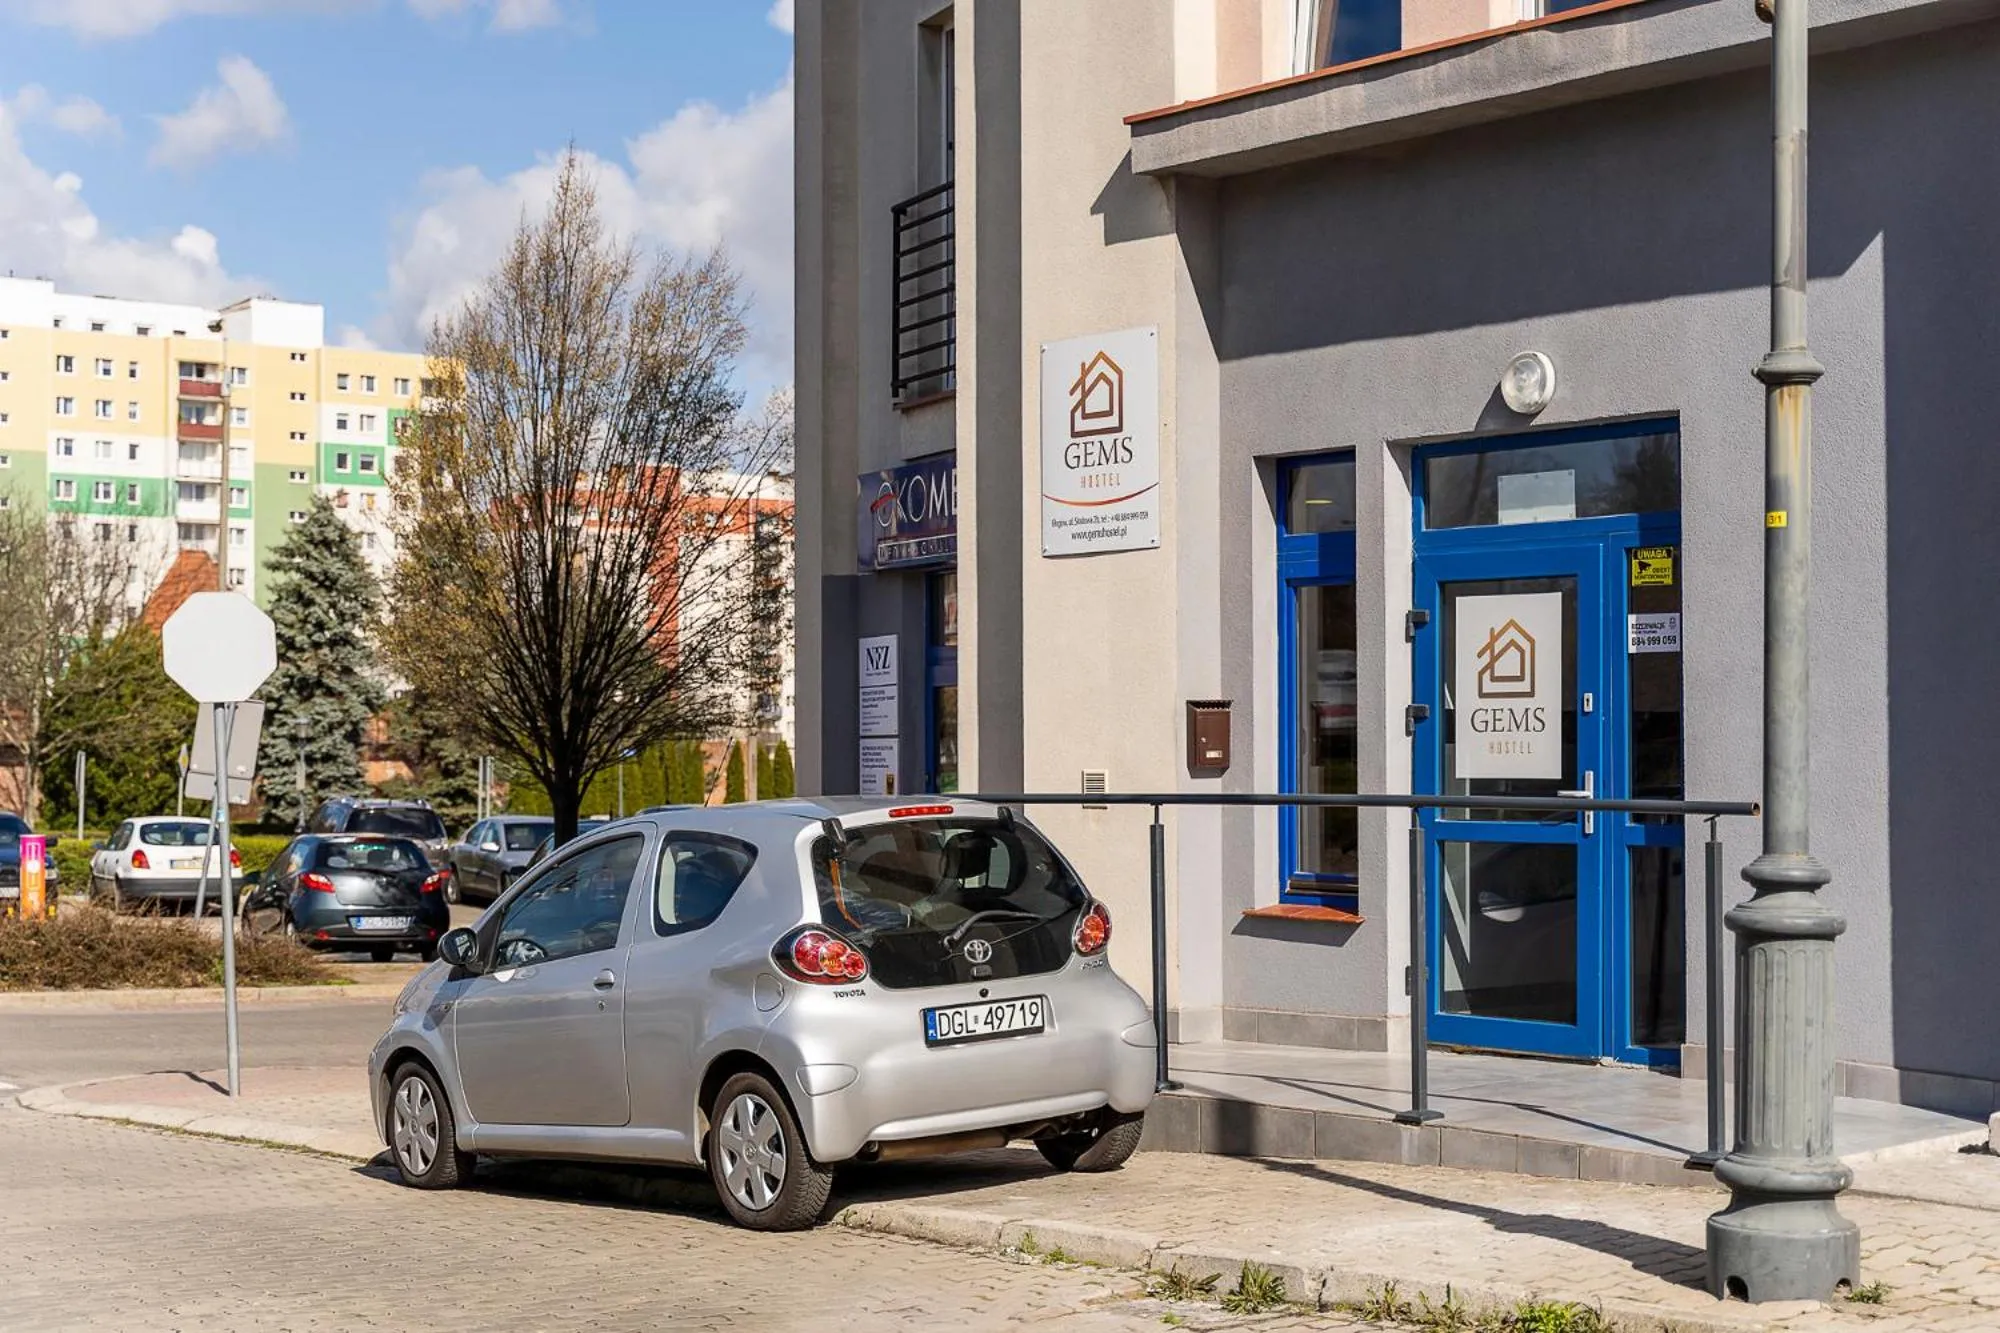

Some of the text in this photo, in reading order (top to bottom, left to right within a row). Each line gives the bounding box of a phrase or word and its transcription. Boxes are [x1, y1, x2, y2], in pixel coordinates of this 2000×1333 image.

[1064, 437, 1133, 469] GEMS
[1081, 473, 1120, 488] HOSTEL
[1637, 548, 1668, 559] UWAGA
[1470, 707, 1546, 733] GEMS
[1489, 740, 1533, 754] HOSTEL
[833, 989, 866, 998] TOYOTA
[938, 1011, 976, 1037] DGL
[983, 1001, 1040, 1031] 49719
